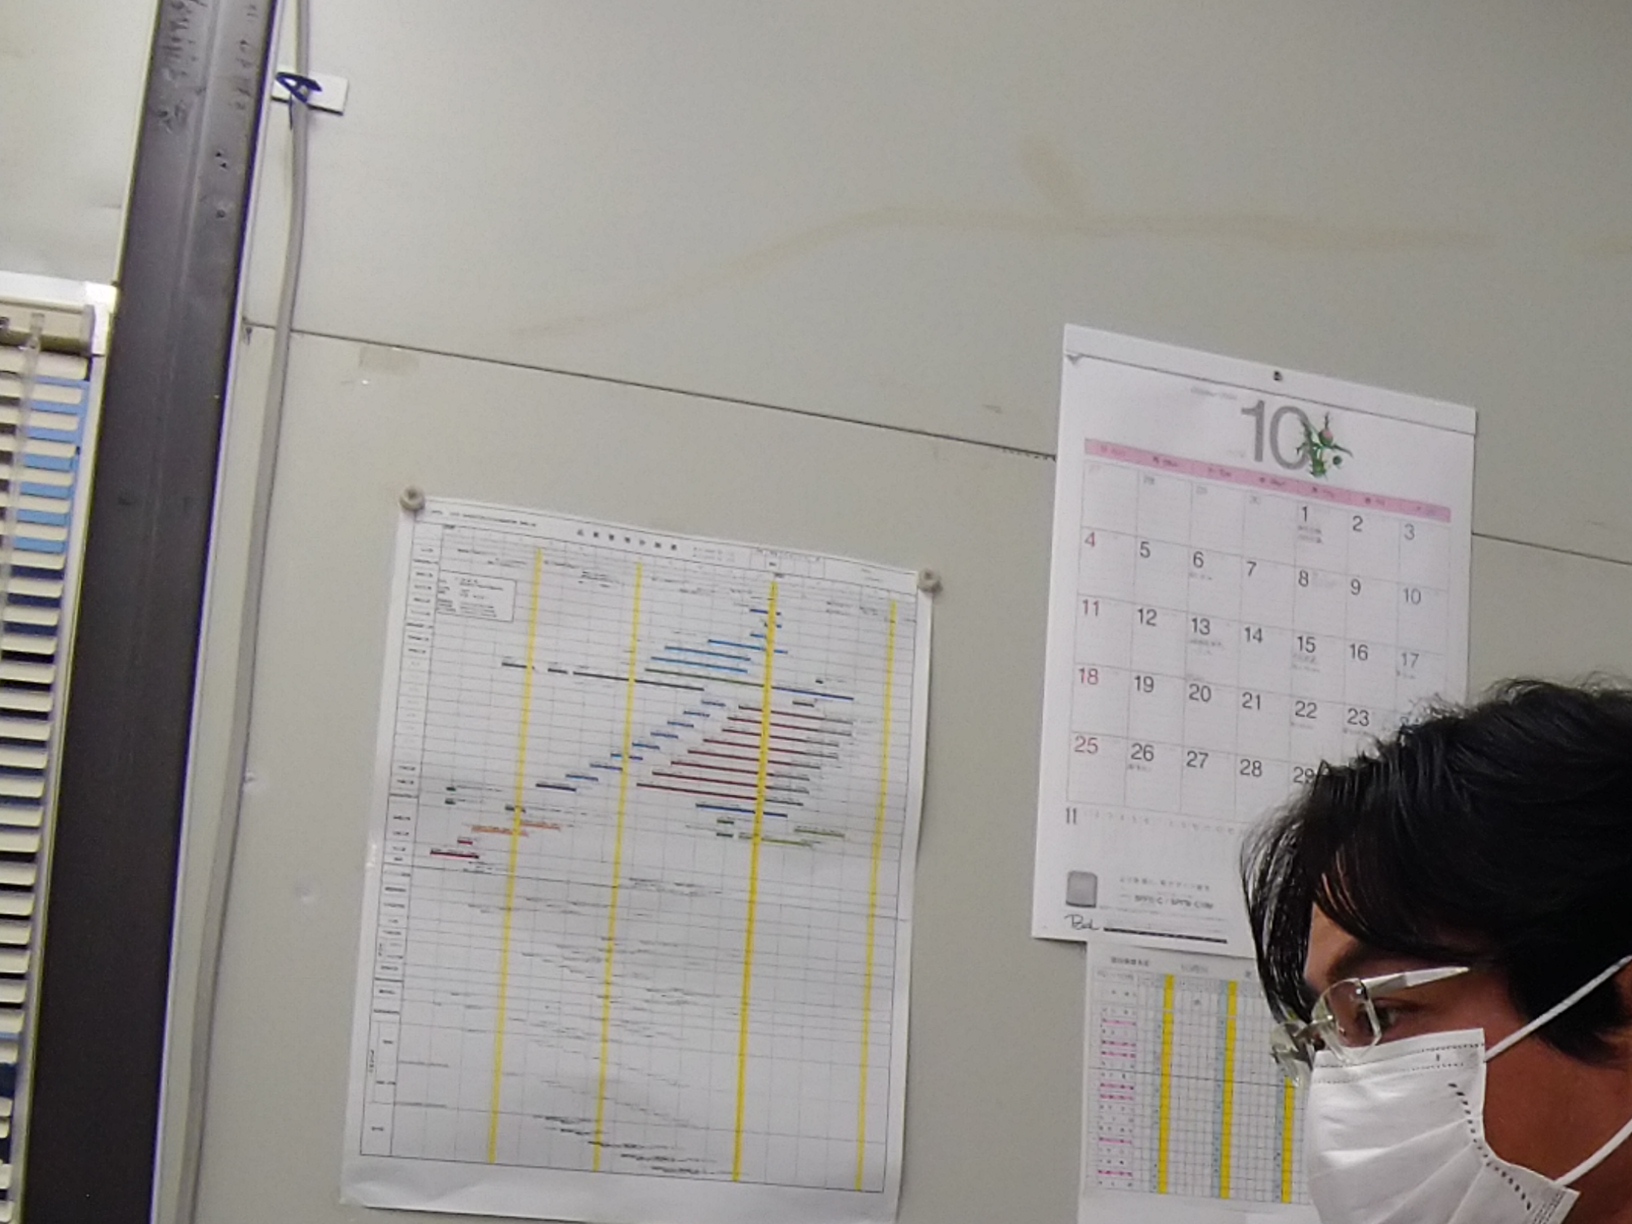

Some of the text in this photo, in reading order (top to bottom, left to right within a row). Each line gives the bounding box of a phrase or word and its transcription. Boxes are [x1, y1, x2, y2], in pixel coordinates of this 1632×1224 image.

[1241, 399, 1311, 470] 10
[1302, 505, 1308, 522] 1
[1352, 515, 1364, 533] 2
[1403, 522, 1416, 541] 3
[1084, 531, 1422, 606] 4 5 6 7 8 9 10
[1082, 598, 1420, 669] 11 12 13 14 15 16 17
[1078, 667, 1370, 727] 18 19 20 21 22 23
[1074, 735, 1099, 755] 25
[1130, 742, 1155, 762] 26
[1185, 750, 1209, 769] 27
[1239, 758, 1263, 778] 28
